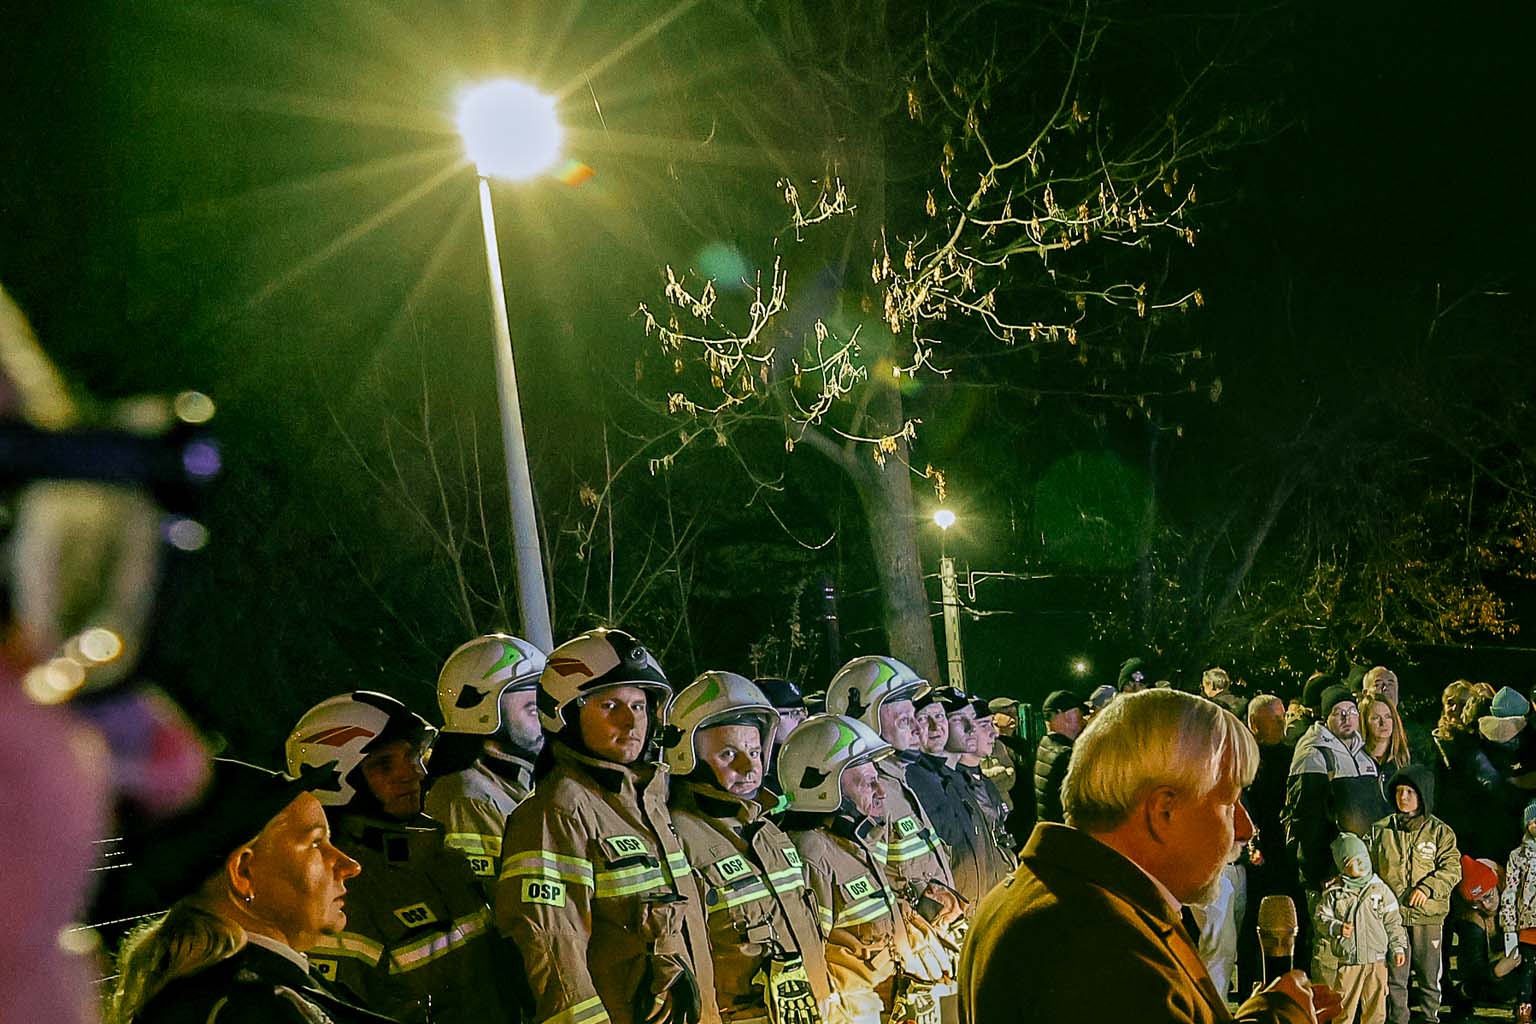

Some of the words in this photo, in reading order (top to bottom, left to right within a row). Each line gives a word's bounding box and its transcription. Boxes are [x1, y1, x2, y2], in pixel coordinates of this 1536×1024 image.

[901, 819, 915, 832] OSP
[615, 838, 641, 852] OSP
[470, 858, 489, 872] SP
[722, 860, 744, 875] OSP
[528, 883, 561, 901] OSP
[850, 880, 869, 896] OSP
[401, 907, 429, 924] OSP
